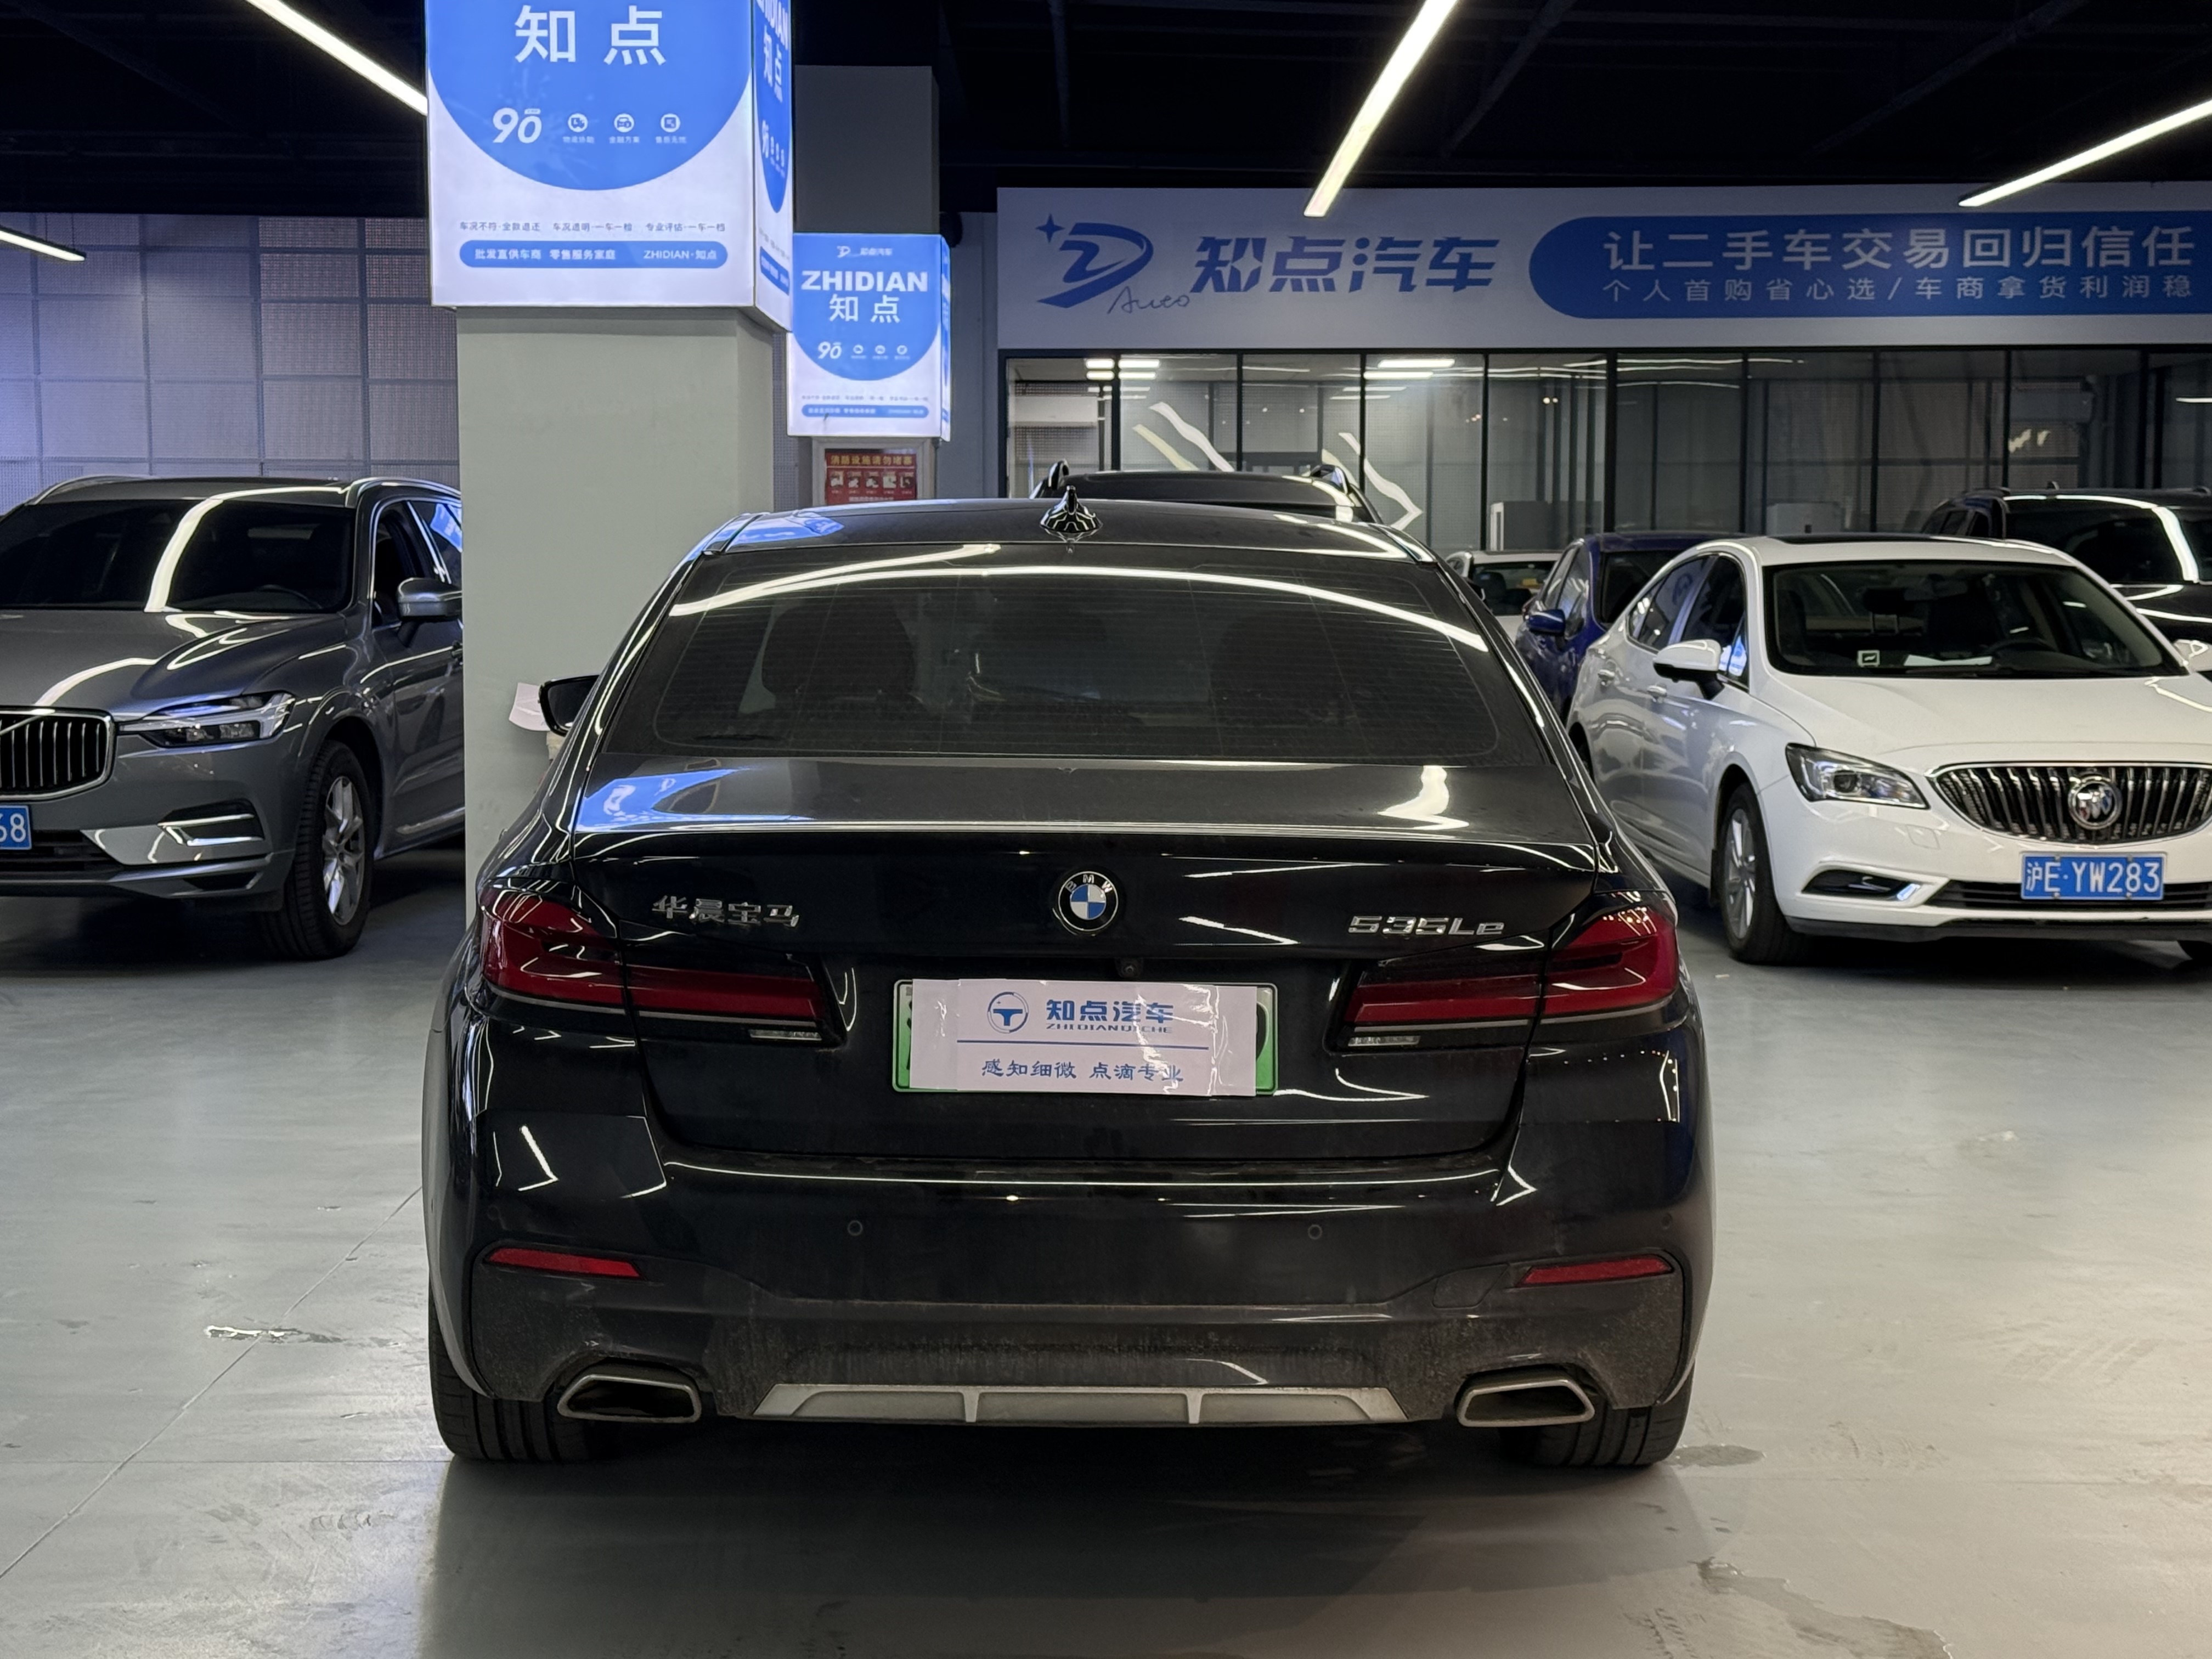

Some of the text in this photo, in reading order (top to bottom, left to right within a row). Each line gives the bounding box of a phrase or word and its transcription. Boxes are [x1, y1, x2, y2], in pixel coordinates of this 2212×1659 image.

[515, 5, 667, 65] 知点
[493, 108, 542, 143] 90
[475, 249, 541, 260] 批发直供车商
[550, 249, 616, 260] 零售服务家庭
[1603, 226, 2194, 272] 让二手车交易回归信任
[1189, 236, 1500, 293] 知点汽车
[801, 270, 928, 292] ZHIDIAN
[1602, 275, 2192, 302] 个人首购省心选/车商拿货利润稳
[829, 294, 900, 323] 知点
[818, 341, 842, 359] 90
[1065, 874, 1113, 893] BMW
[2025, 861, 2160, 893] 沪E·YW283
[652, 895, 799, 927] 华晨宝马
[1348, 915, 1504, 935] 535Le
[1046, 999, 1173, 1023] 知点汽车
[982, 1058, 1184, 1082] 感知细微 点滴专业
